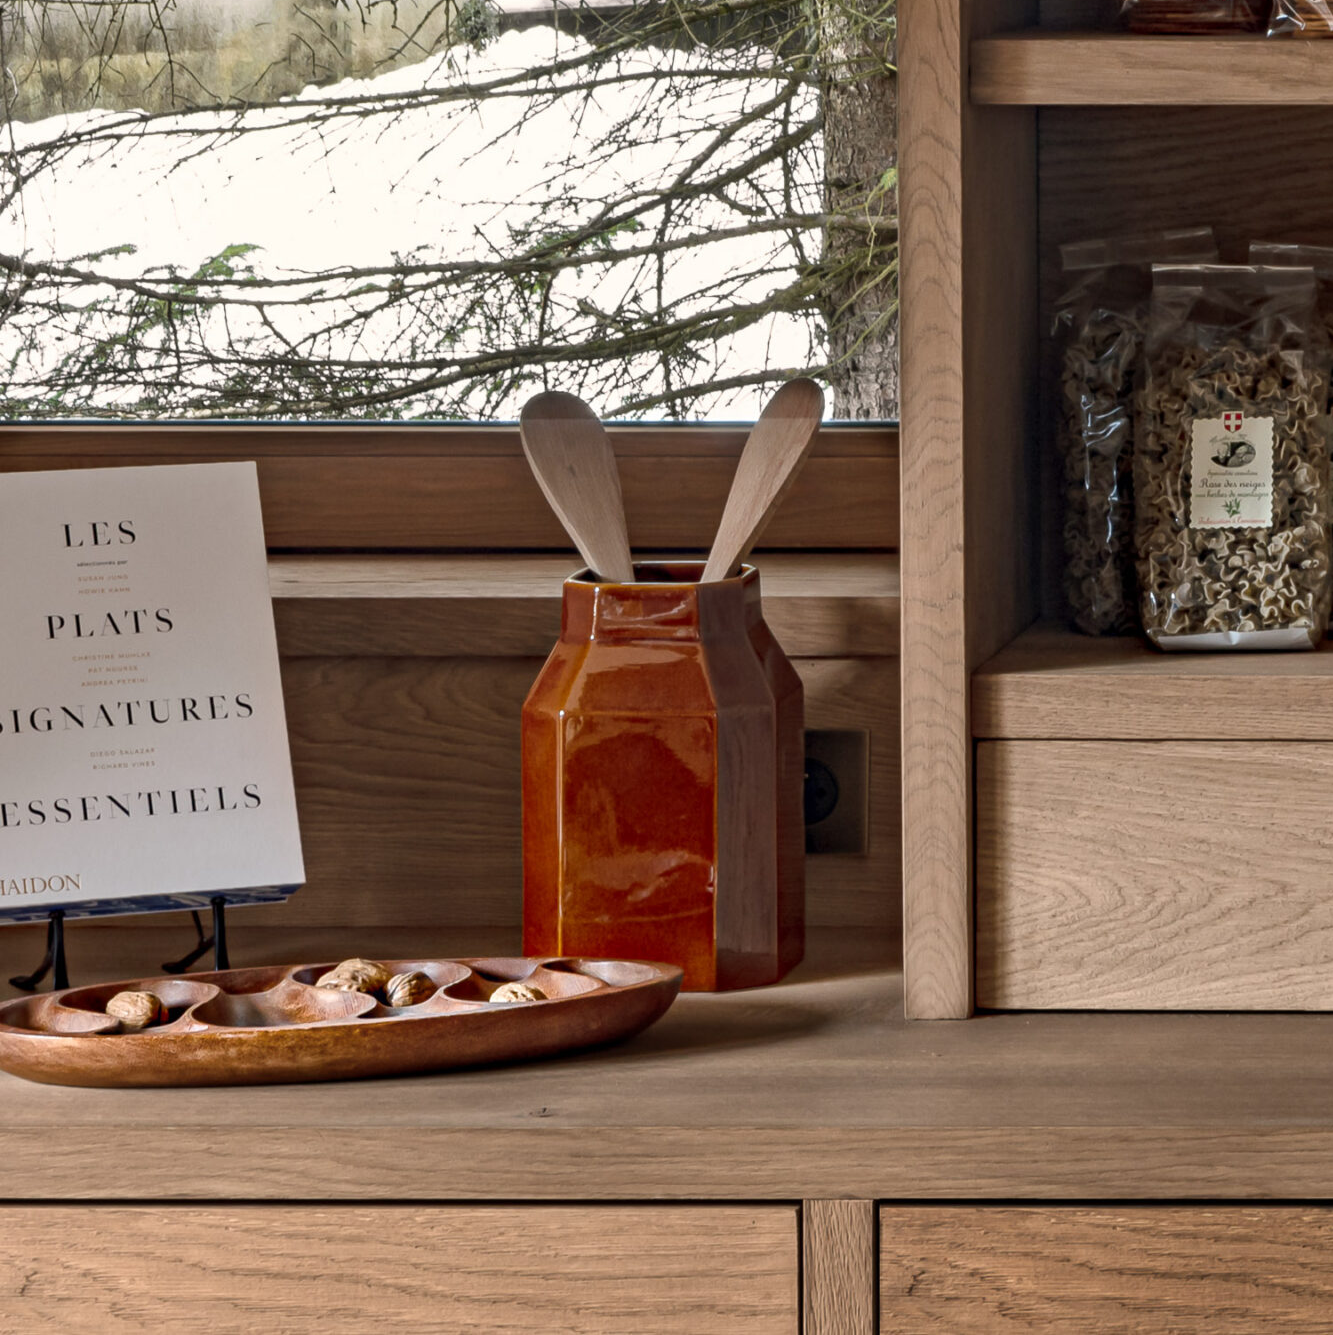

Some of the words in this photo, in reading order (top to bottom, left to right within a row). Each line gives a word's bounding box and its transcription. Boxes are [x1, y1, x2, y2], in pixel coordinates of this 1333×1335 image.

[61, 520, 136, 548] LES
[45, 608, 173, 640] PLATS
[72, 653, 115, 662] CHRISTINE
[81, 679, 113, 687] ANDREA
[0, 693, 254, 734] IGNATURES
[90, 750, 116, 758] DIEGO
[119, 747, 156, 756] SALAZAR
[93, 762, 129, 770] RICHARD
[132, 760, 156, 768] VINES
[0, 783, 262, 828] ESSENTIELS
